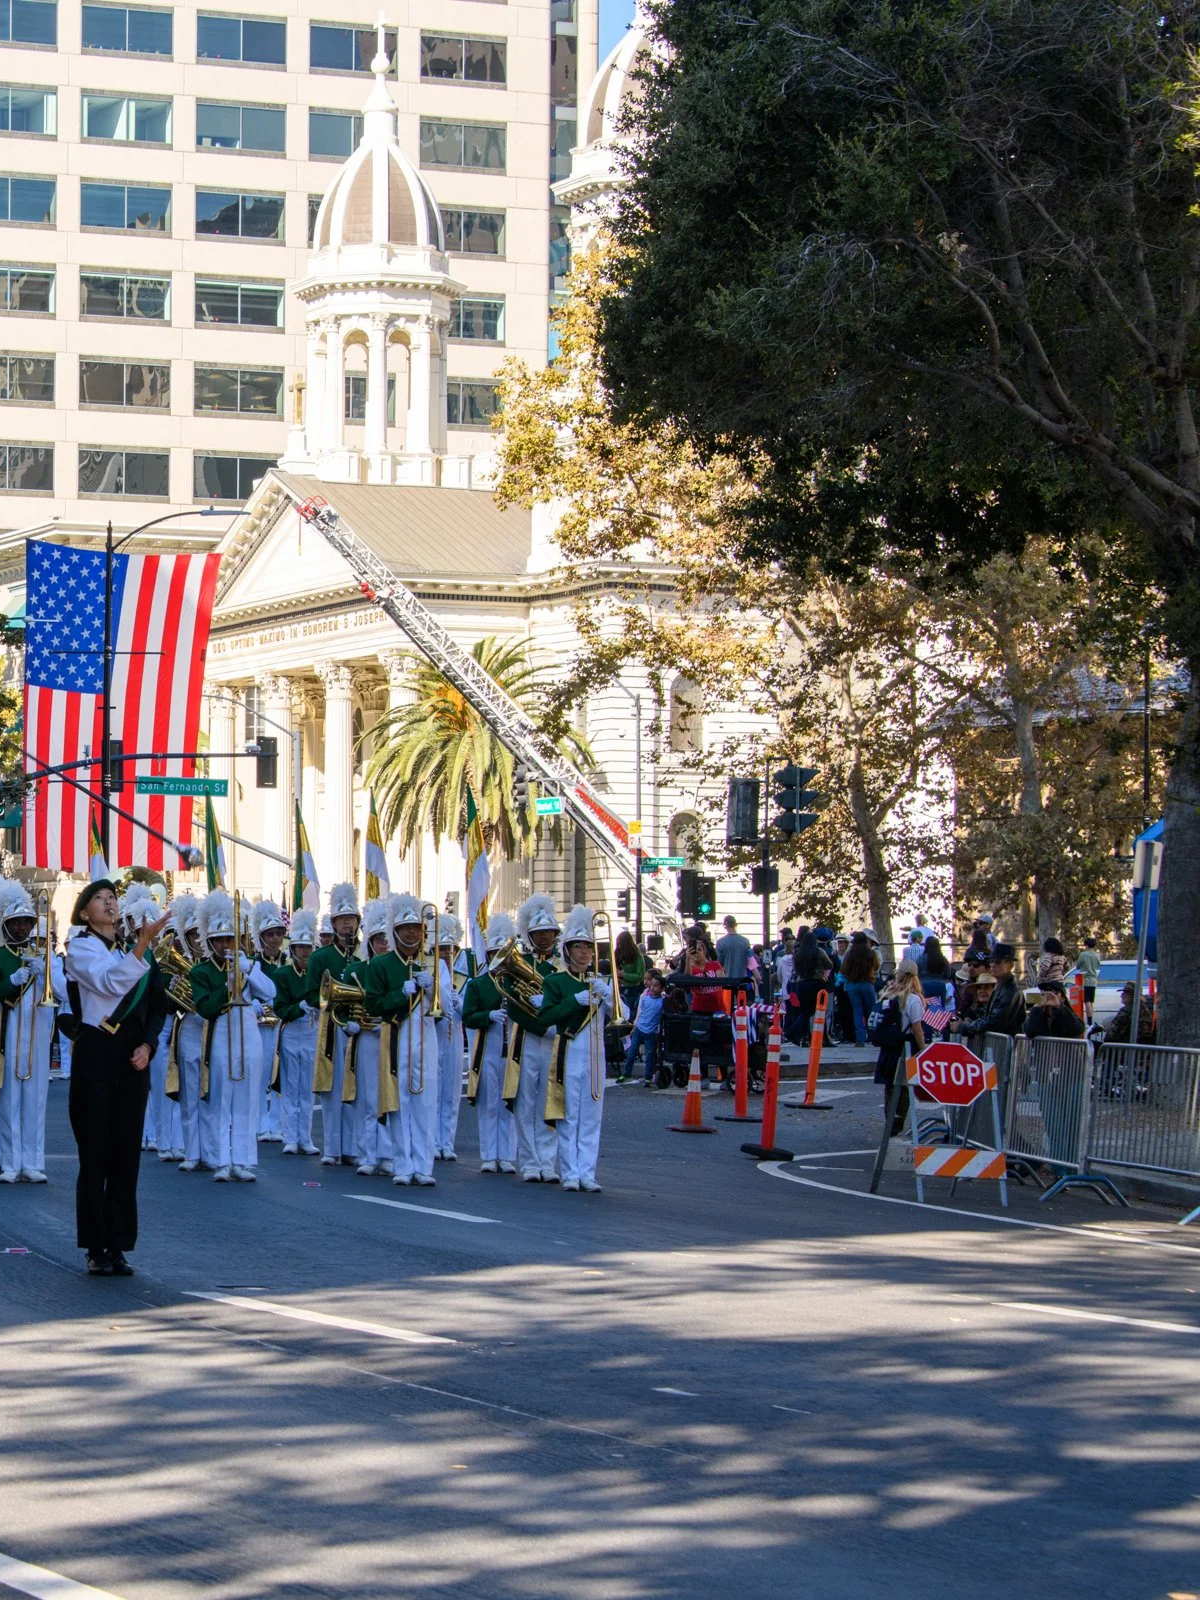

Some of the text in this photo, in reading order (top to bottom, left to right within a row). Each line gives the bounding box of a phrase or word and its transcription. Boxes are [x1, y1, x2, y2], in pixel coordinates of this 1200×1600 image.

[230, 637, 255, 650] OPTIMO
[259, 630, 286, 645] MAXIMO
[290, 627, 298, 639] IN
[303, 619, 339, 637] HONOREM
[140, 781, 225, 793] San Fernando St
[601, 810, 618, 829] JOSE
[921, 1059, 981, 1087] STOP
